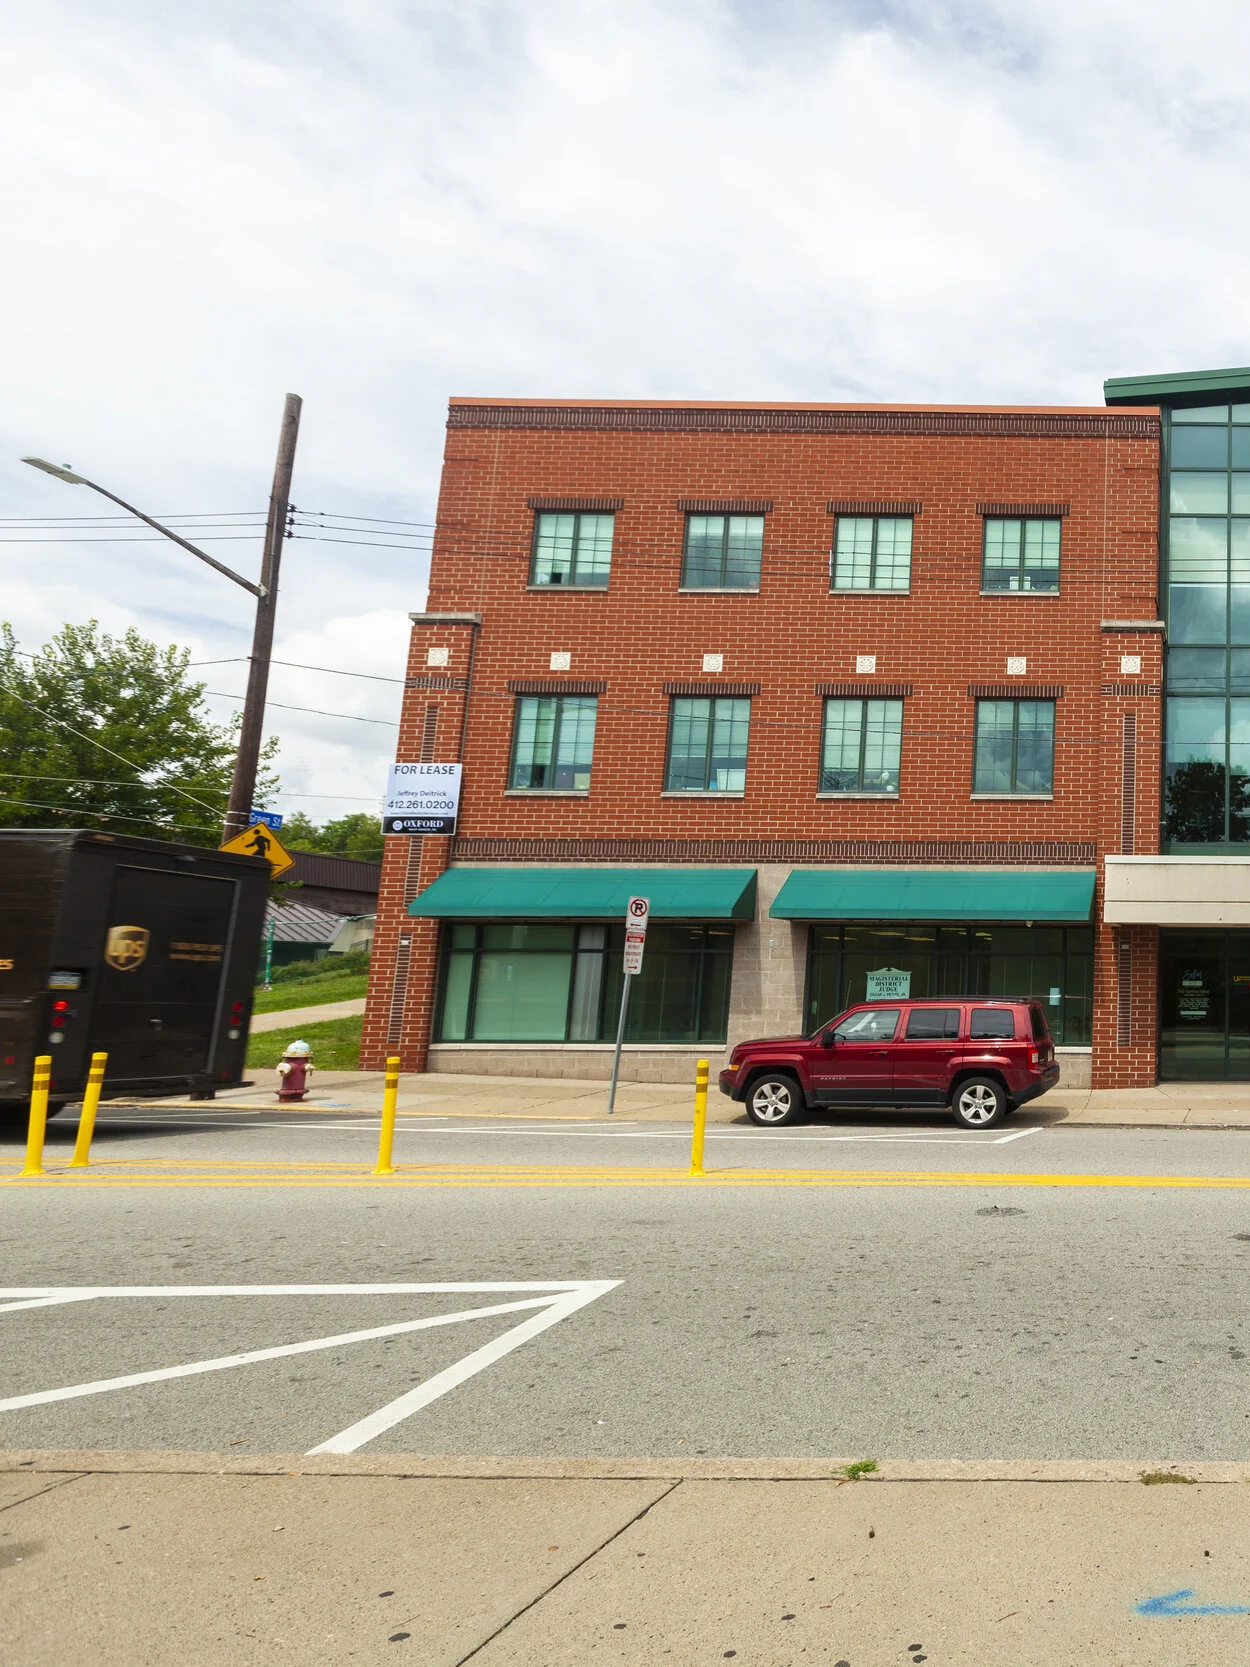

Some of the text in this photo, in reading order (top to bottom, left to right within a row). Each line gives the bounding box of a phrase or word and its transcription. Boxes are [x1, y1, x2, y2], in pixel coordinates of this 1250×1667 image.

[394, 765, 455, 775] FOR LEASE
[387, 800, 454, 809] 412.261.0200
[249, 812, 281, 827] Green St
[403, 820, 444, 828] OXFORD
[109, 940, 144, 963] ups
